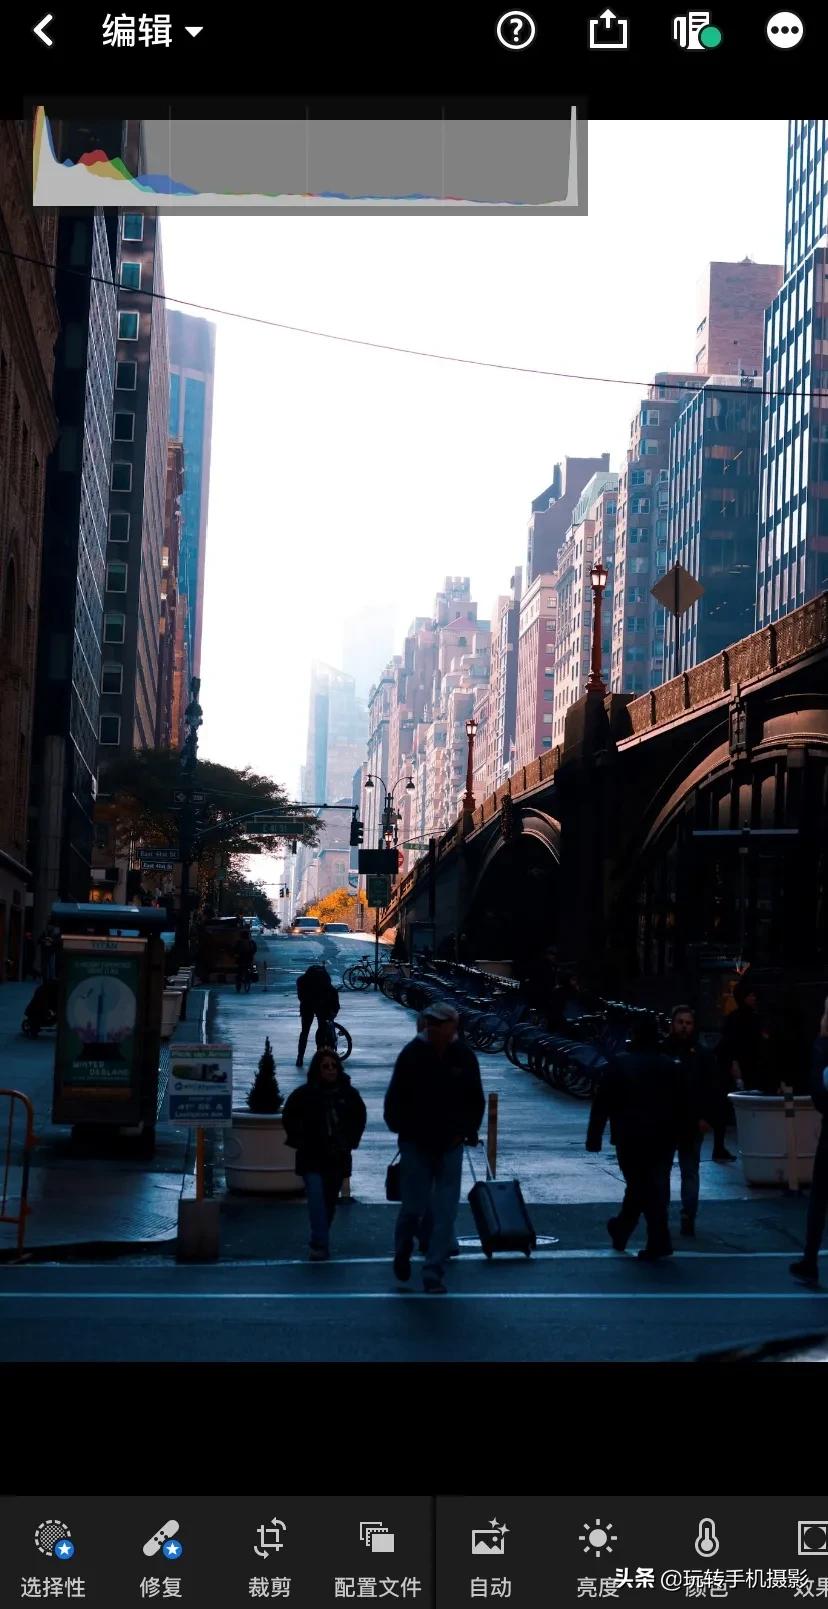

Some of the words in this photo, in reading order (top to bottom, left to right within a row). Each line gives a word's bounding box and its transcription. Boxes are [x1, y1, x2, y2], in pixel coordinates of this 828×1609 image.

[102, 13, 172, 47] 编辑
[21, 1577, 85, 1597] 选择性
[140, 1577, 182, 1597] 修复
[249, 1577, 291, 1597] 裁剪
[335, 1577, 421, 1597] 配置文件
[471, 1577, 511, 1597] 自动
[577, 1577, 620, 1598] 亮度
